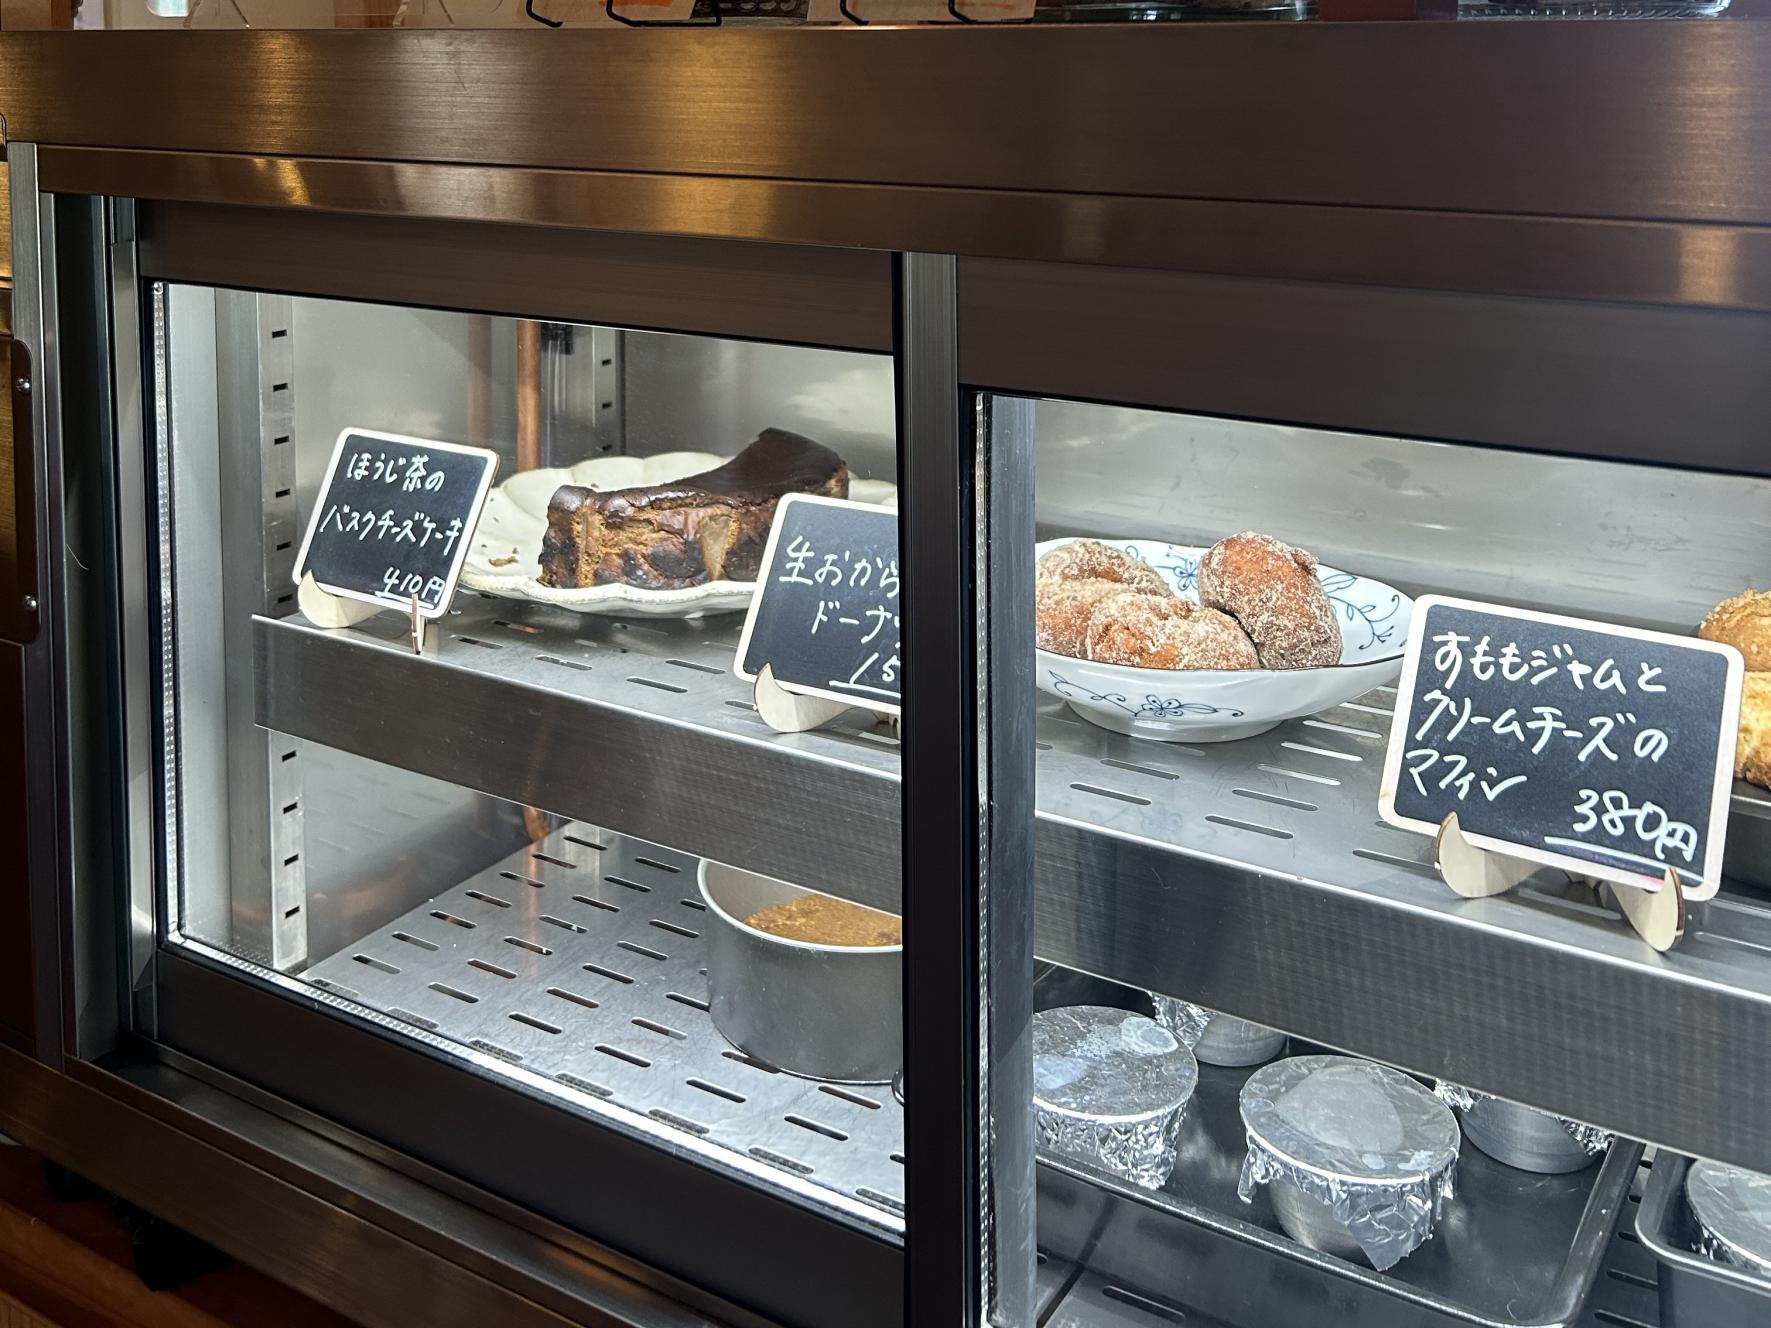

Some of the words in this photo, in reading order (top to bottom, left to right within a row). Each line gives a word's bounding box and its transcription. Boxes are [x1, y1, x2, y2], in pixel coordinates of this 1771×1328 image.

[347, 453, 445, 492] ほうじ茶の
[320, 504, 463, 556] バスクチーズケーキ
[383, 567, 446, 603] 410円
[779, 535, 899, 598] 生おから
[812, 600, 900, 645] ドーナ
[1433, 630, 1667, 694] すももジャムと
[1415, 690, 1669, 762] クリームチーズの
[1405, 748, 1527, 802] マフィン
[1573, 789, 1698, 862] 380円
